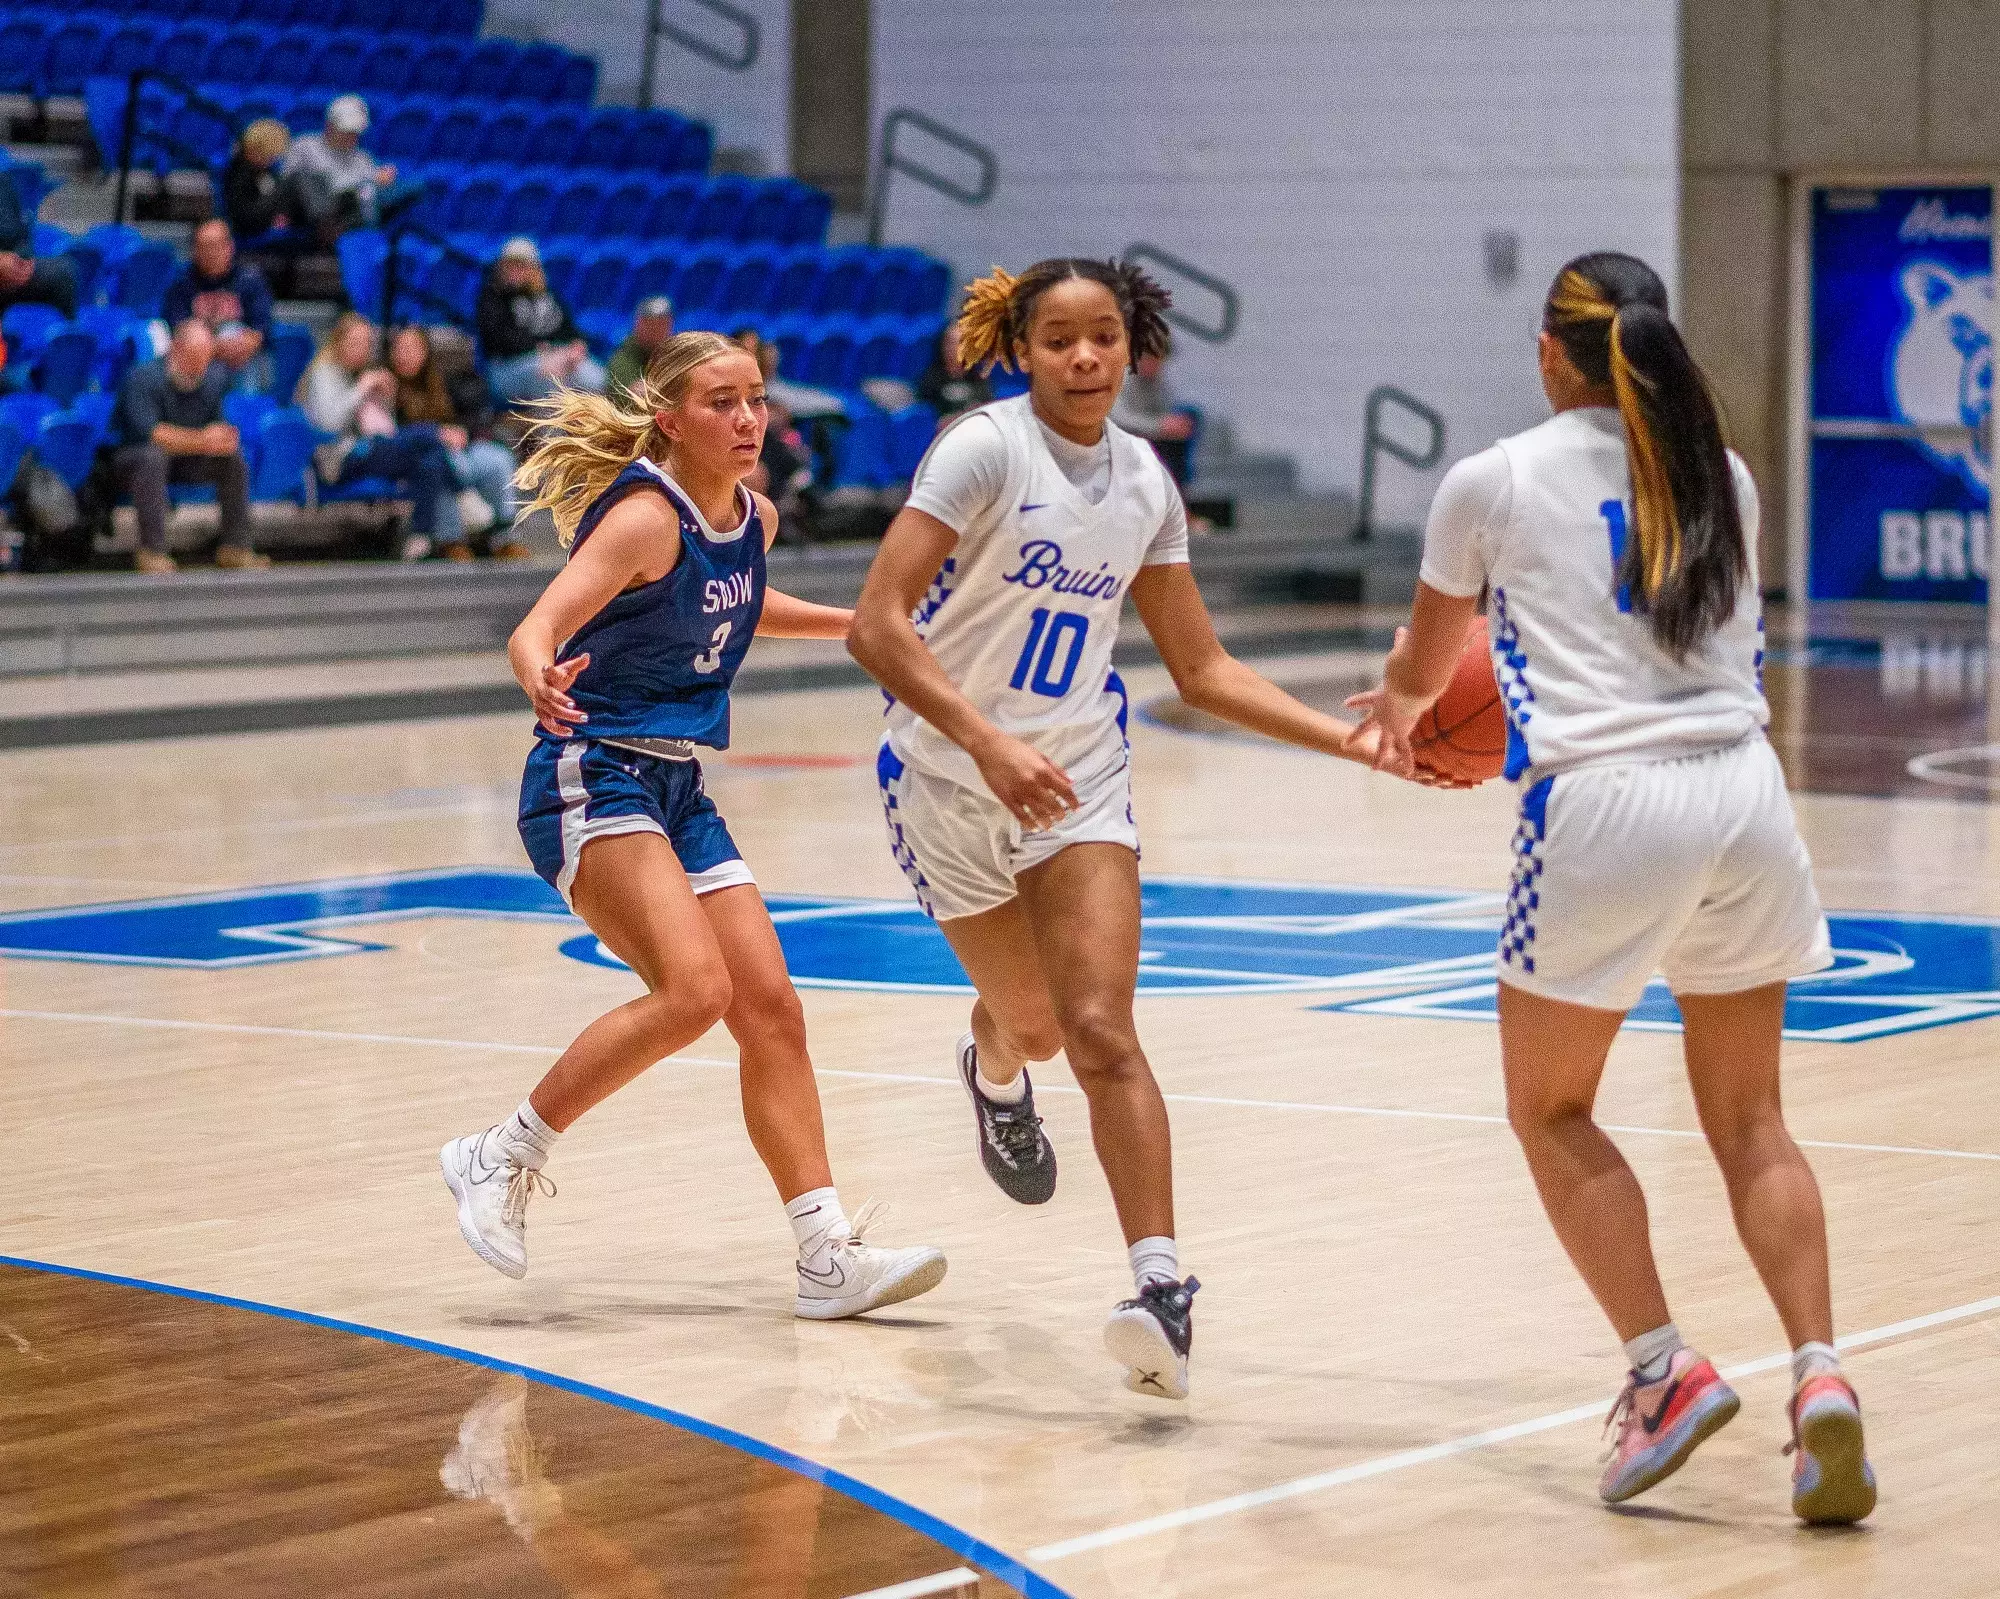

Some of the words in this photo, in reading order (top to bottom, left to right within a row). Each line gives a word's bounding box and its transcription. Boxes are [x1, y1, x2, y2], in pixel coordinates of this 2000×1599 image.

[702, 567, 752, 613] SNOW
[693, 621, 732, 674] 3
[1009, 607, 1090, 698] 10
